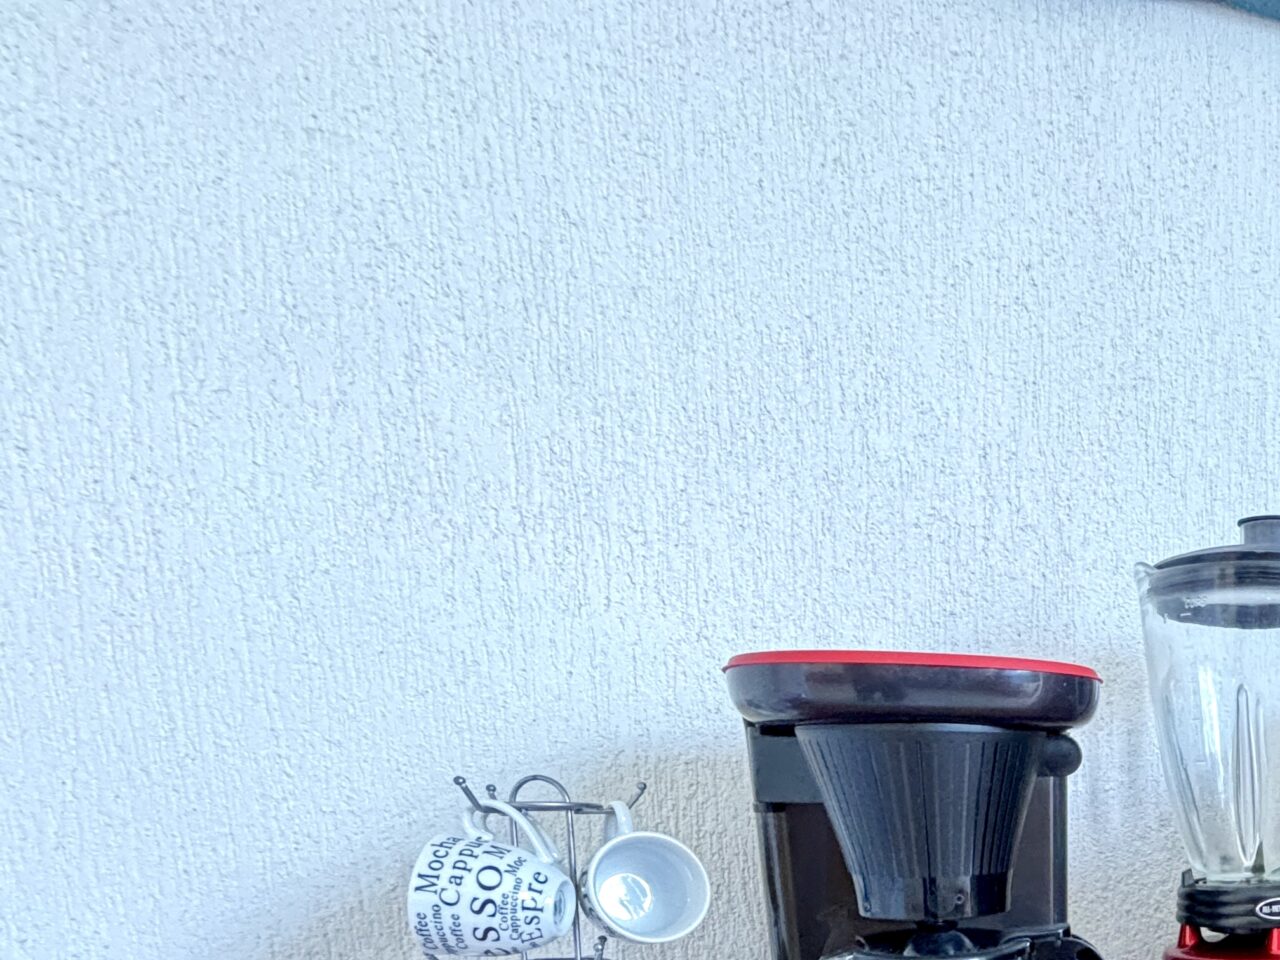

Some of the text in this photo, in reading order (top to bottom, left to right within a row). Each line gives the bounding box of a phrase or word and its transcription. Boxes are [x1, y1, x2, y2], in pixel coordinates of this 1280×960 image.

[414, 836, 462, 895] Mocha
[497, 893, 511, 932] Coffee
[509, 877, 523, 941] Cappuccino
